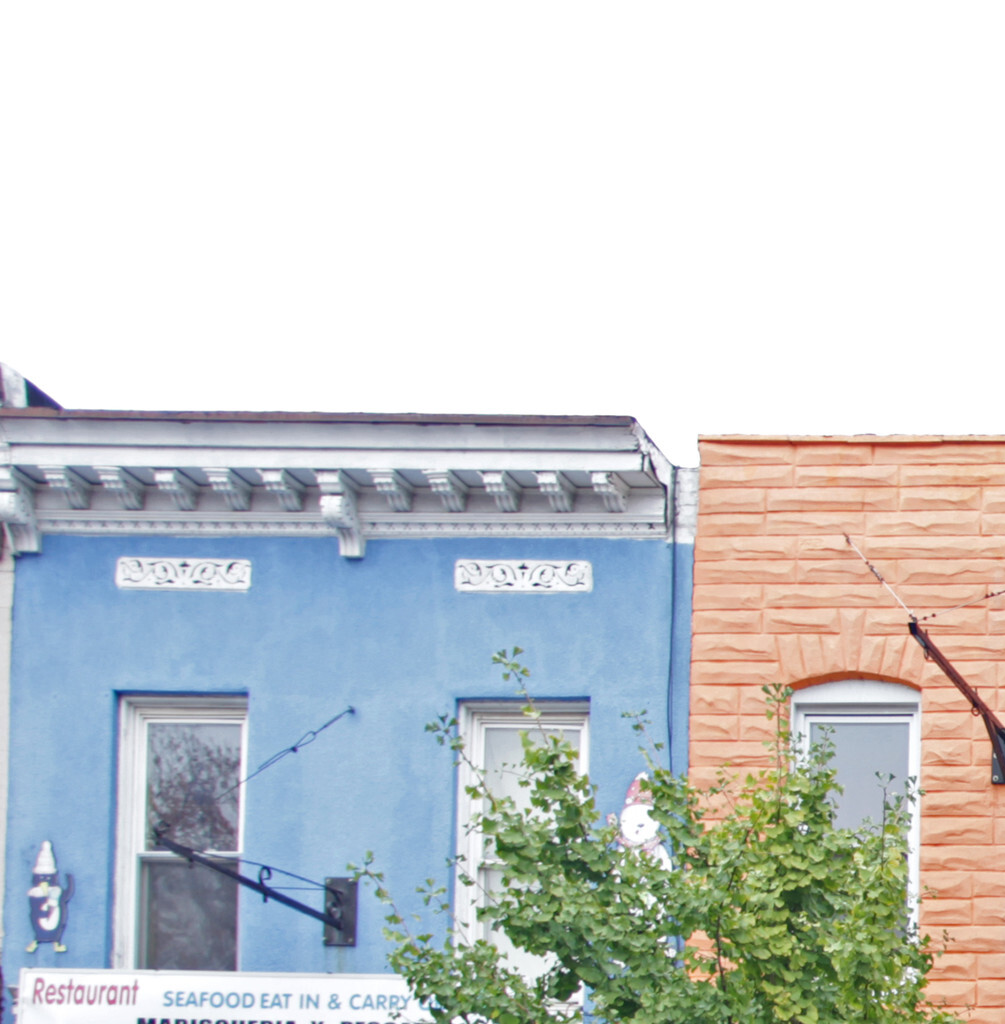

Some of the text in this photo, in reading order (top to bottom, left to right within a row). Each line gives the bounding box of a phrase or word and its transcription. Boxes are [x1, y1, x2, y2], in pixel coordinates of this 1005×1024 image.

[33, 977, 139, 1006] Restaurant
[163, 991, 256, 1009] SEAFOOD
[260, 993, 293, 1009] EAT
[299, 994, 320, 1009] IN
[327, 993, 342, 1010] &
[349, 994, 411, 1011] CARRY
